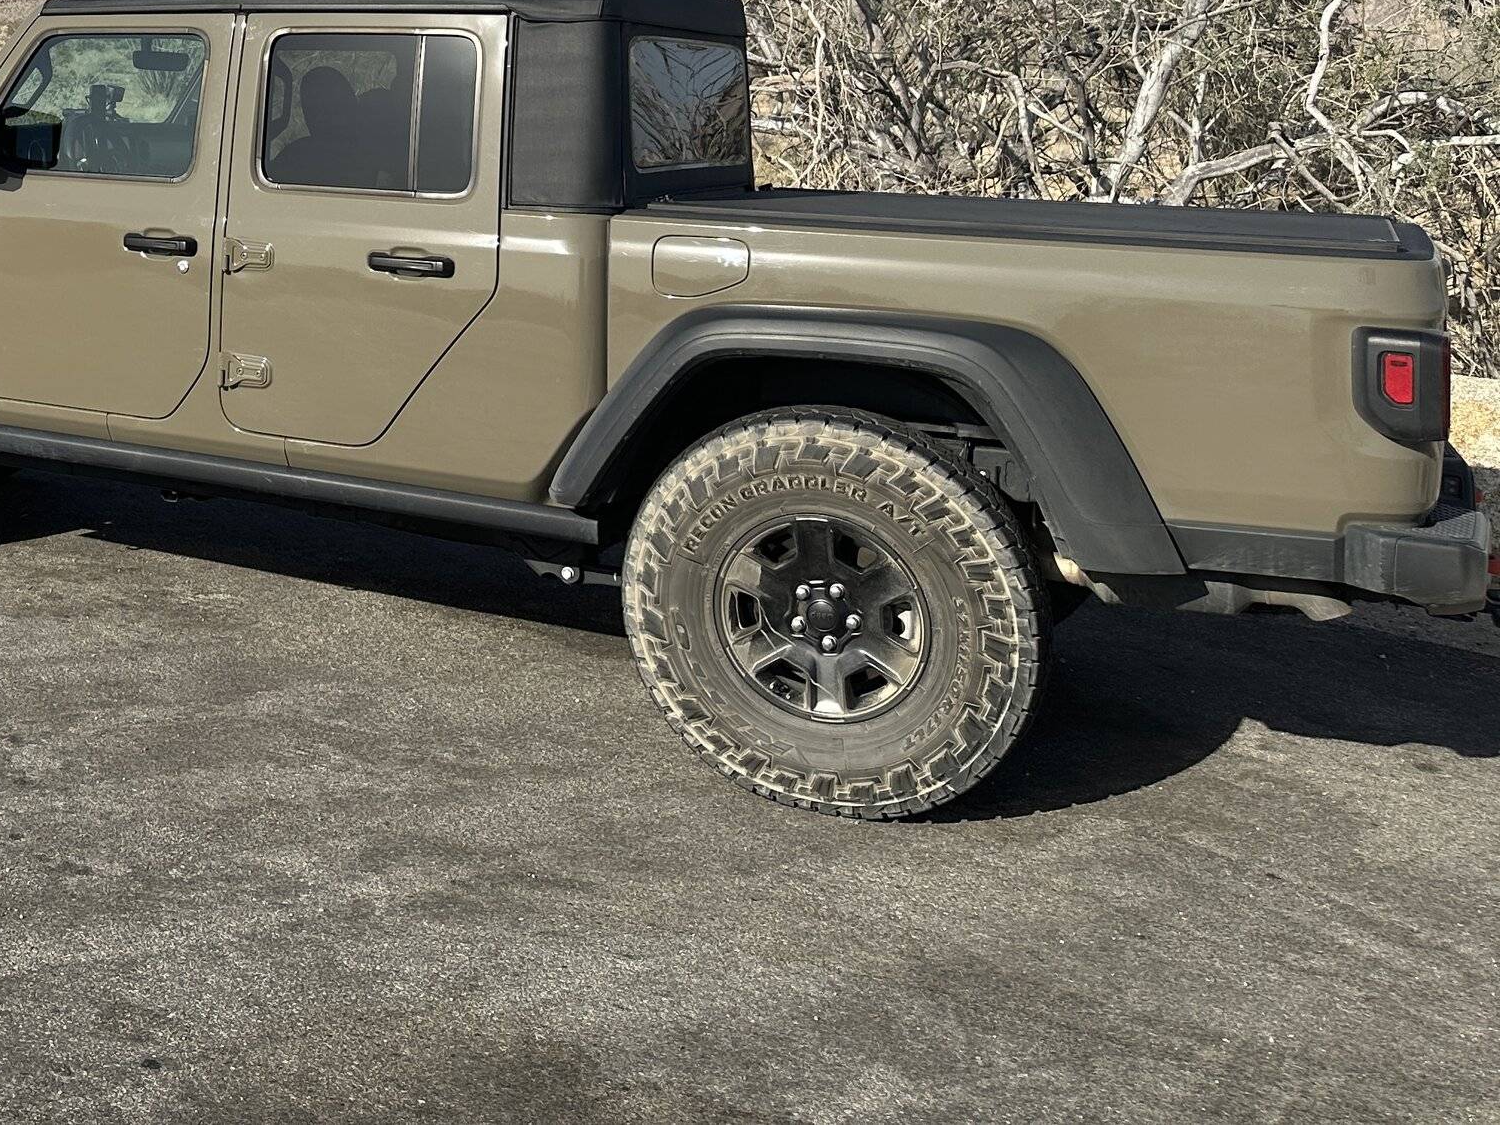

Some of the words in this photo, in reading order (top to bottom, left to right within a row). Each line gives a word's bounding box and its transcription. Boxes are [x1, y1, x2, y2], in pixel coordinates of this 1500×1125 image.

[682, 494, 739, 555] RECON
[738, 474, 868, 503] GRAPPLER
[876, 500, 927, 537] A/T
